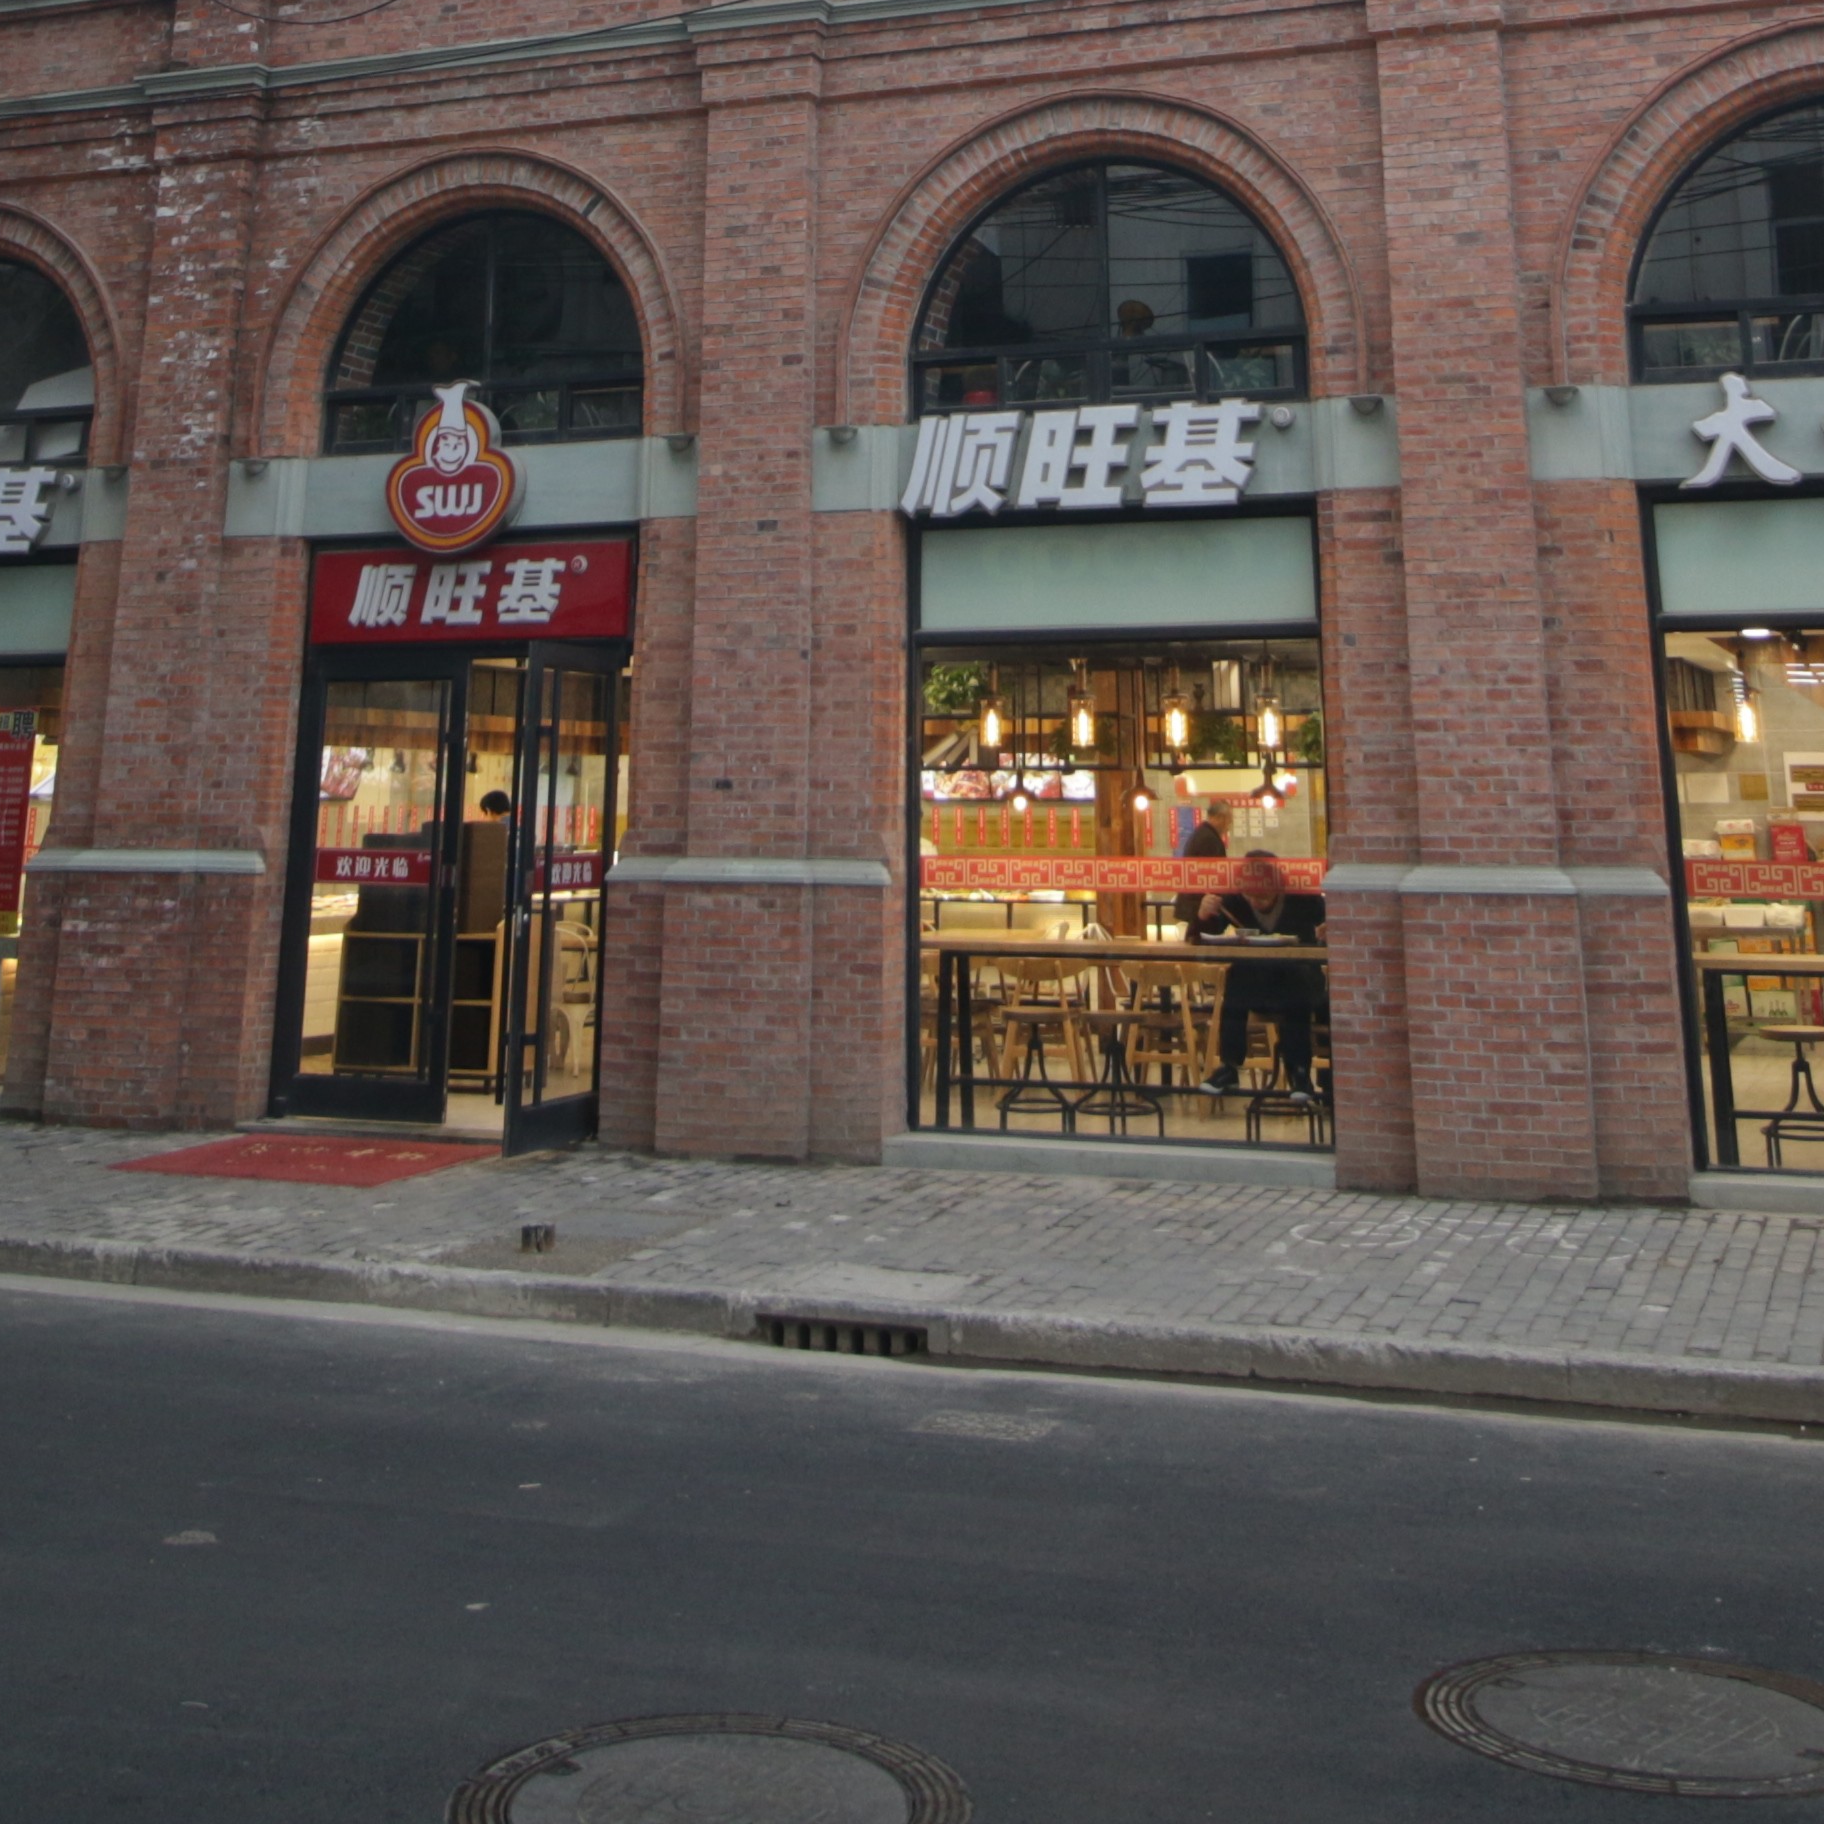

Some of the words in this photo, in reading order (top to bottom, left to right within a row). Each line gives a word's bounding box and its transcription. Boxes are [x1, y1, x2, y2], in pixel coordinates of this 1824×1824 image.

[900, 398, 1262, 518] 顺旺基
[414, 483, 483, 519] SWJ
[348, 558, 566, 627] 顺旺基
[336, 856, 409, 878] 欢迎光临
